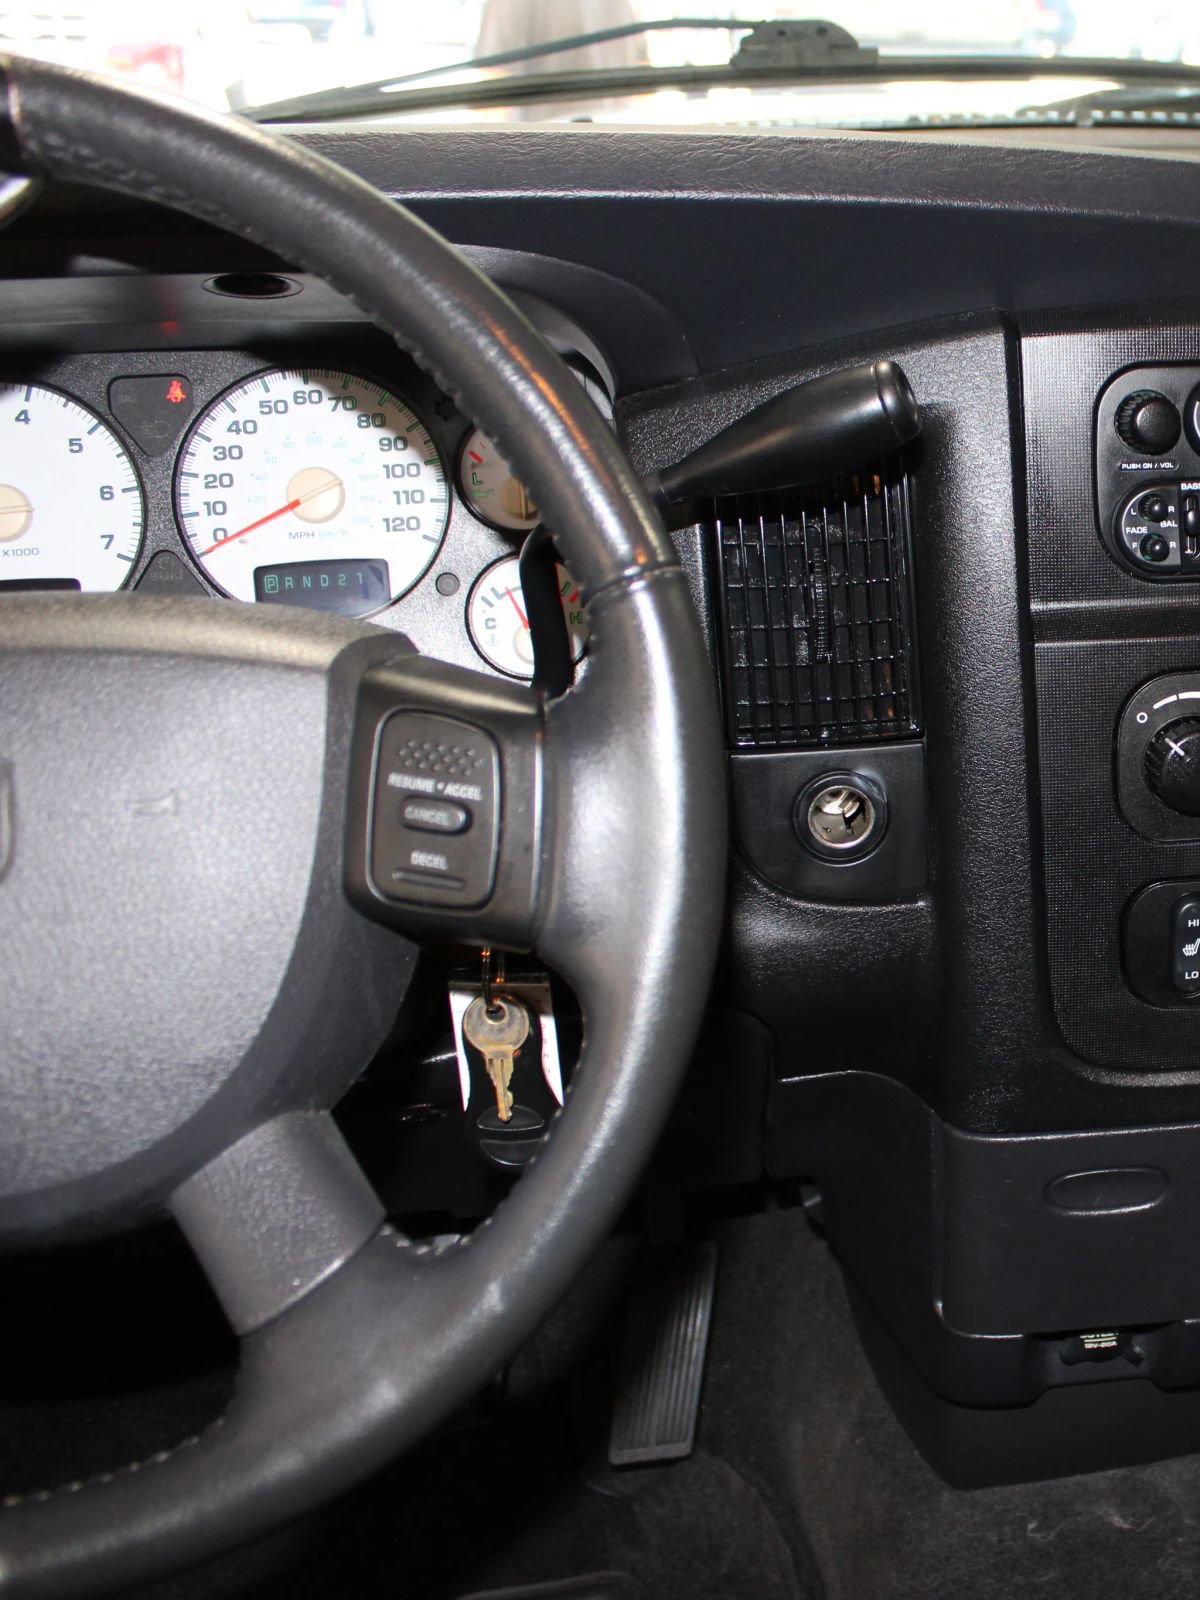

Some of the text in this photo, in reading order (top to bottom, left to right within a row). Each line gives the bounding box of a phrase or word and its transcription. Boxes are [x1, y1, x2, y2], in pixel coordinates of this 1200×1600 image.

[293, 390, 323, 405] 60
[328, 395, 357, 412] 70
[259, 399, 289, 415] 50
[15, 410, 31, 425] 4
[357, 413, 386, 429] 80
[227, 419, 258, 435] 40
[68, 438, 84, 454] 5
[379, 436, 408, 452] 90
[213, 445, 243, 461] 30
[382, 463, 421, 479] 100
[472, 472, 483, 485] L
[204, 473, 234, 489] 20
[99, 485, 115, 501] 6
[393, 489, 426, 505] 110
[203, 501, 227, 516] 10
[1130, 507, 1137, 516] L
[1168, 505, 1175, 513] R
[382, 516, 421, 532] 120
[1126, 526, 1148, 534] FADE
[1160, 520, 1178, 528] BAL
[100, 534, 115, 550] 7
[213, 528, 229, 542] 0
[288, 531, 315, 540] MPH
[1169, 541, 1176, 549] R
[285, 577, 294, 589] R
[303, 576, 312, 588] N
[320, 574, 329, 587] D
[338, 573, 347, 586] 2
[357, 572, 364, 584] 1
[484, 617, 497, 630] C
[569, 611, 583, 625] H
[387, 772, 482, 801] RESUME ACCEL
[404, 805, 450, 826] CANCEL
[411, 850, 448, 870] DECEL
[1188, 919, 1200, 927] HI
[1185, 971, 1199, 979] LO
